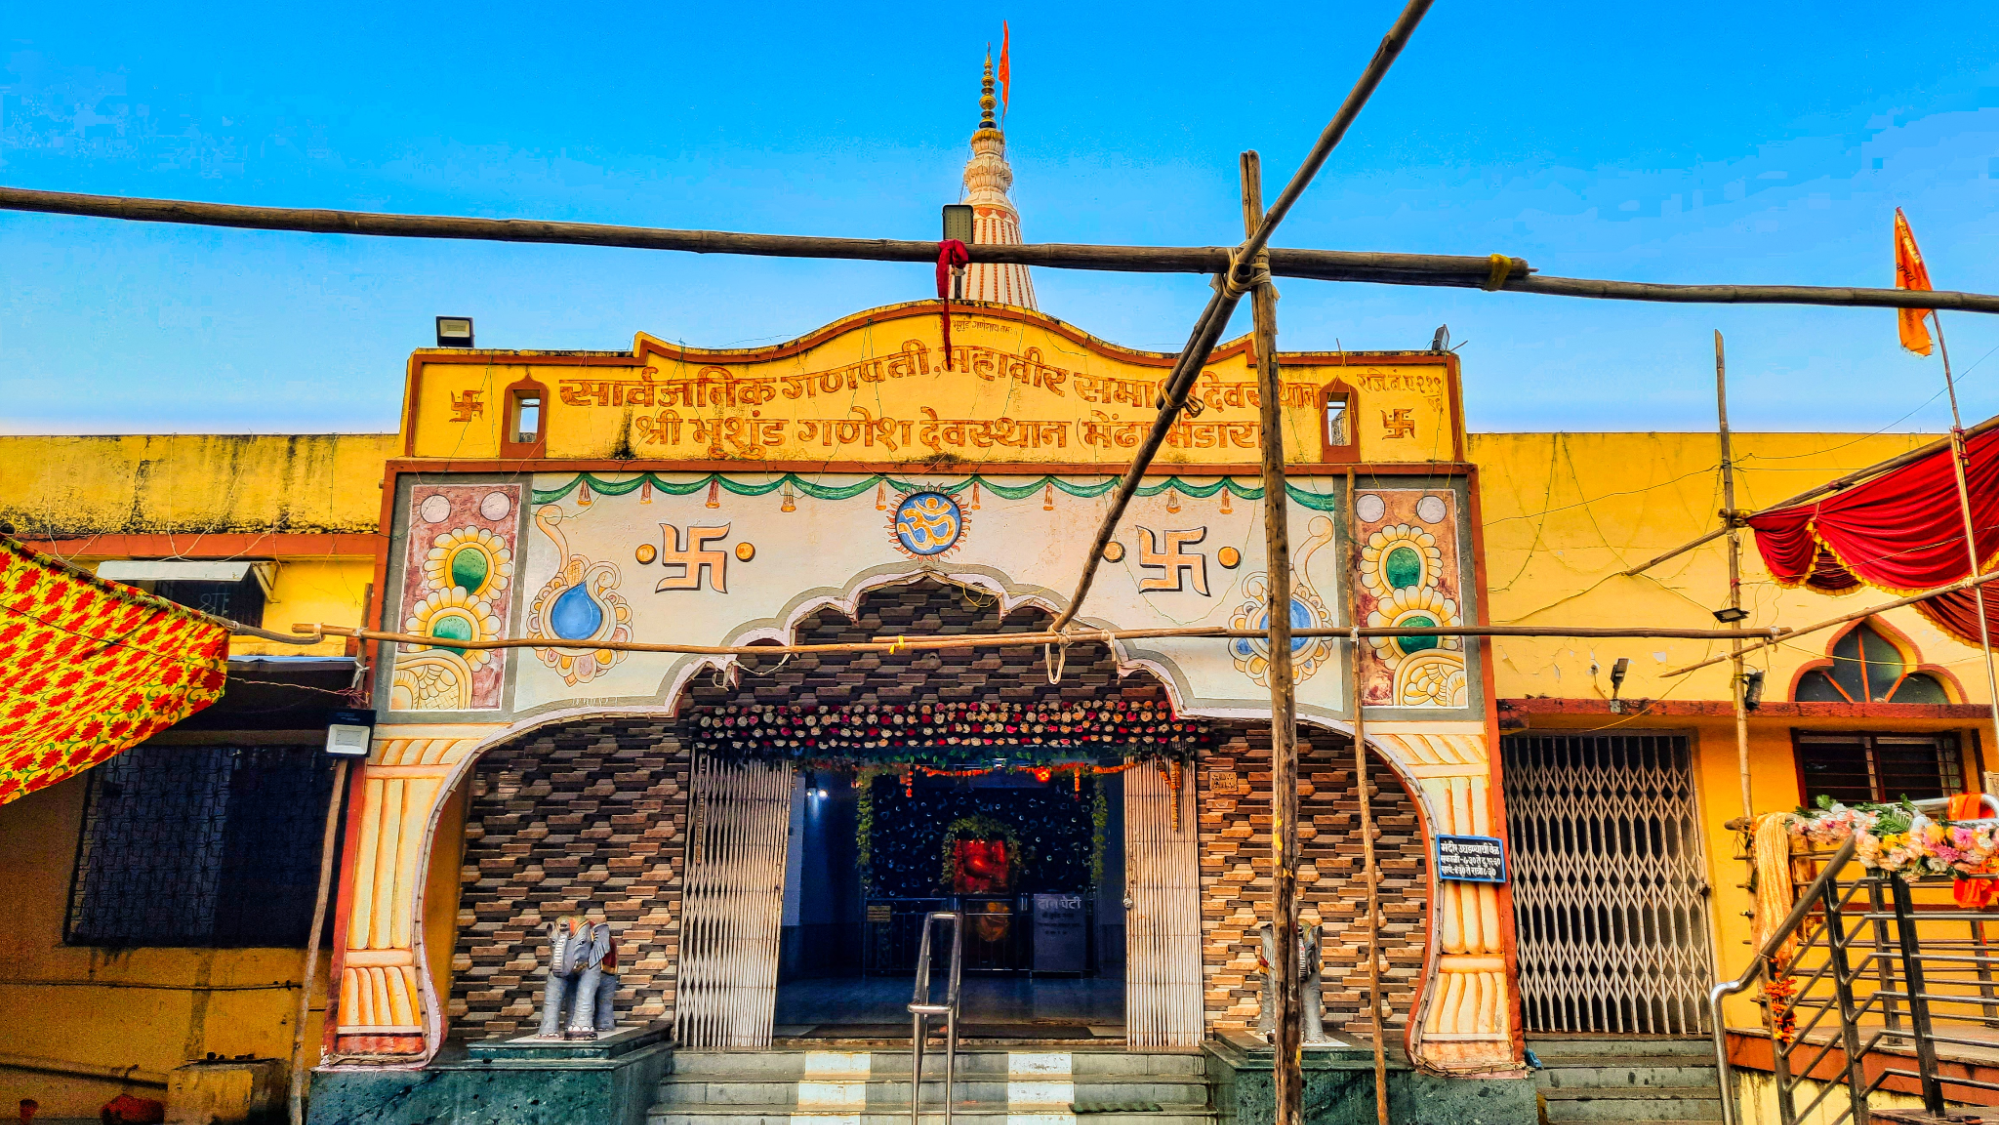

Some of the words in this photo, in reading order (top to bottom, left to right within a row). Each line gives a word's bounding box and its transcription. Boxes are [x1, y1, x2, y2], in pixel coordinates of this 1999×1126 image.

[559, 366, 776, 408] सार्वजनिक
[635, 408, 683, 446] श्री
[797, 405, 914, 452] गणेश
[919, 406, 1072, 453] देवस्थान
[1060, 896, 1082, 909] पेटी
